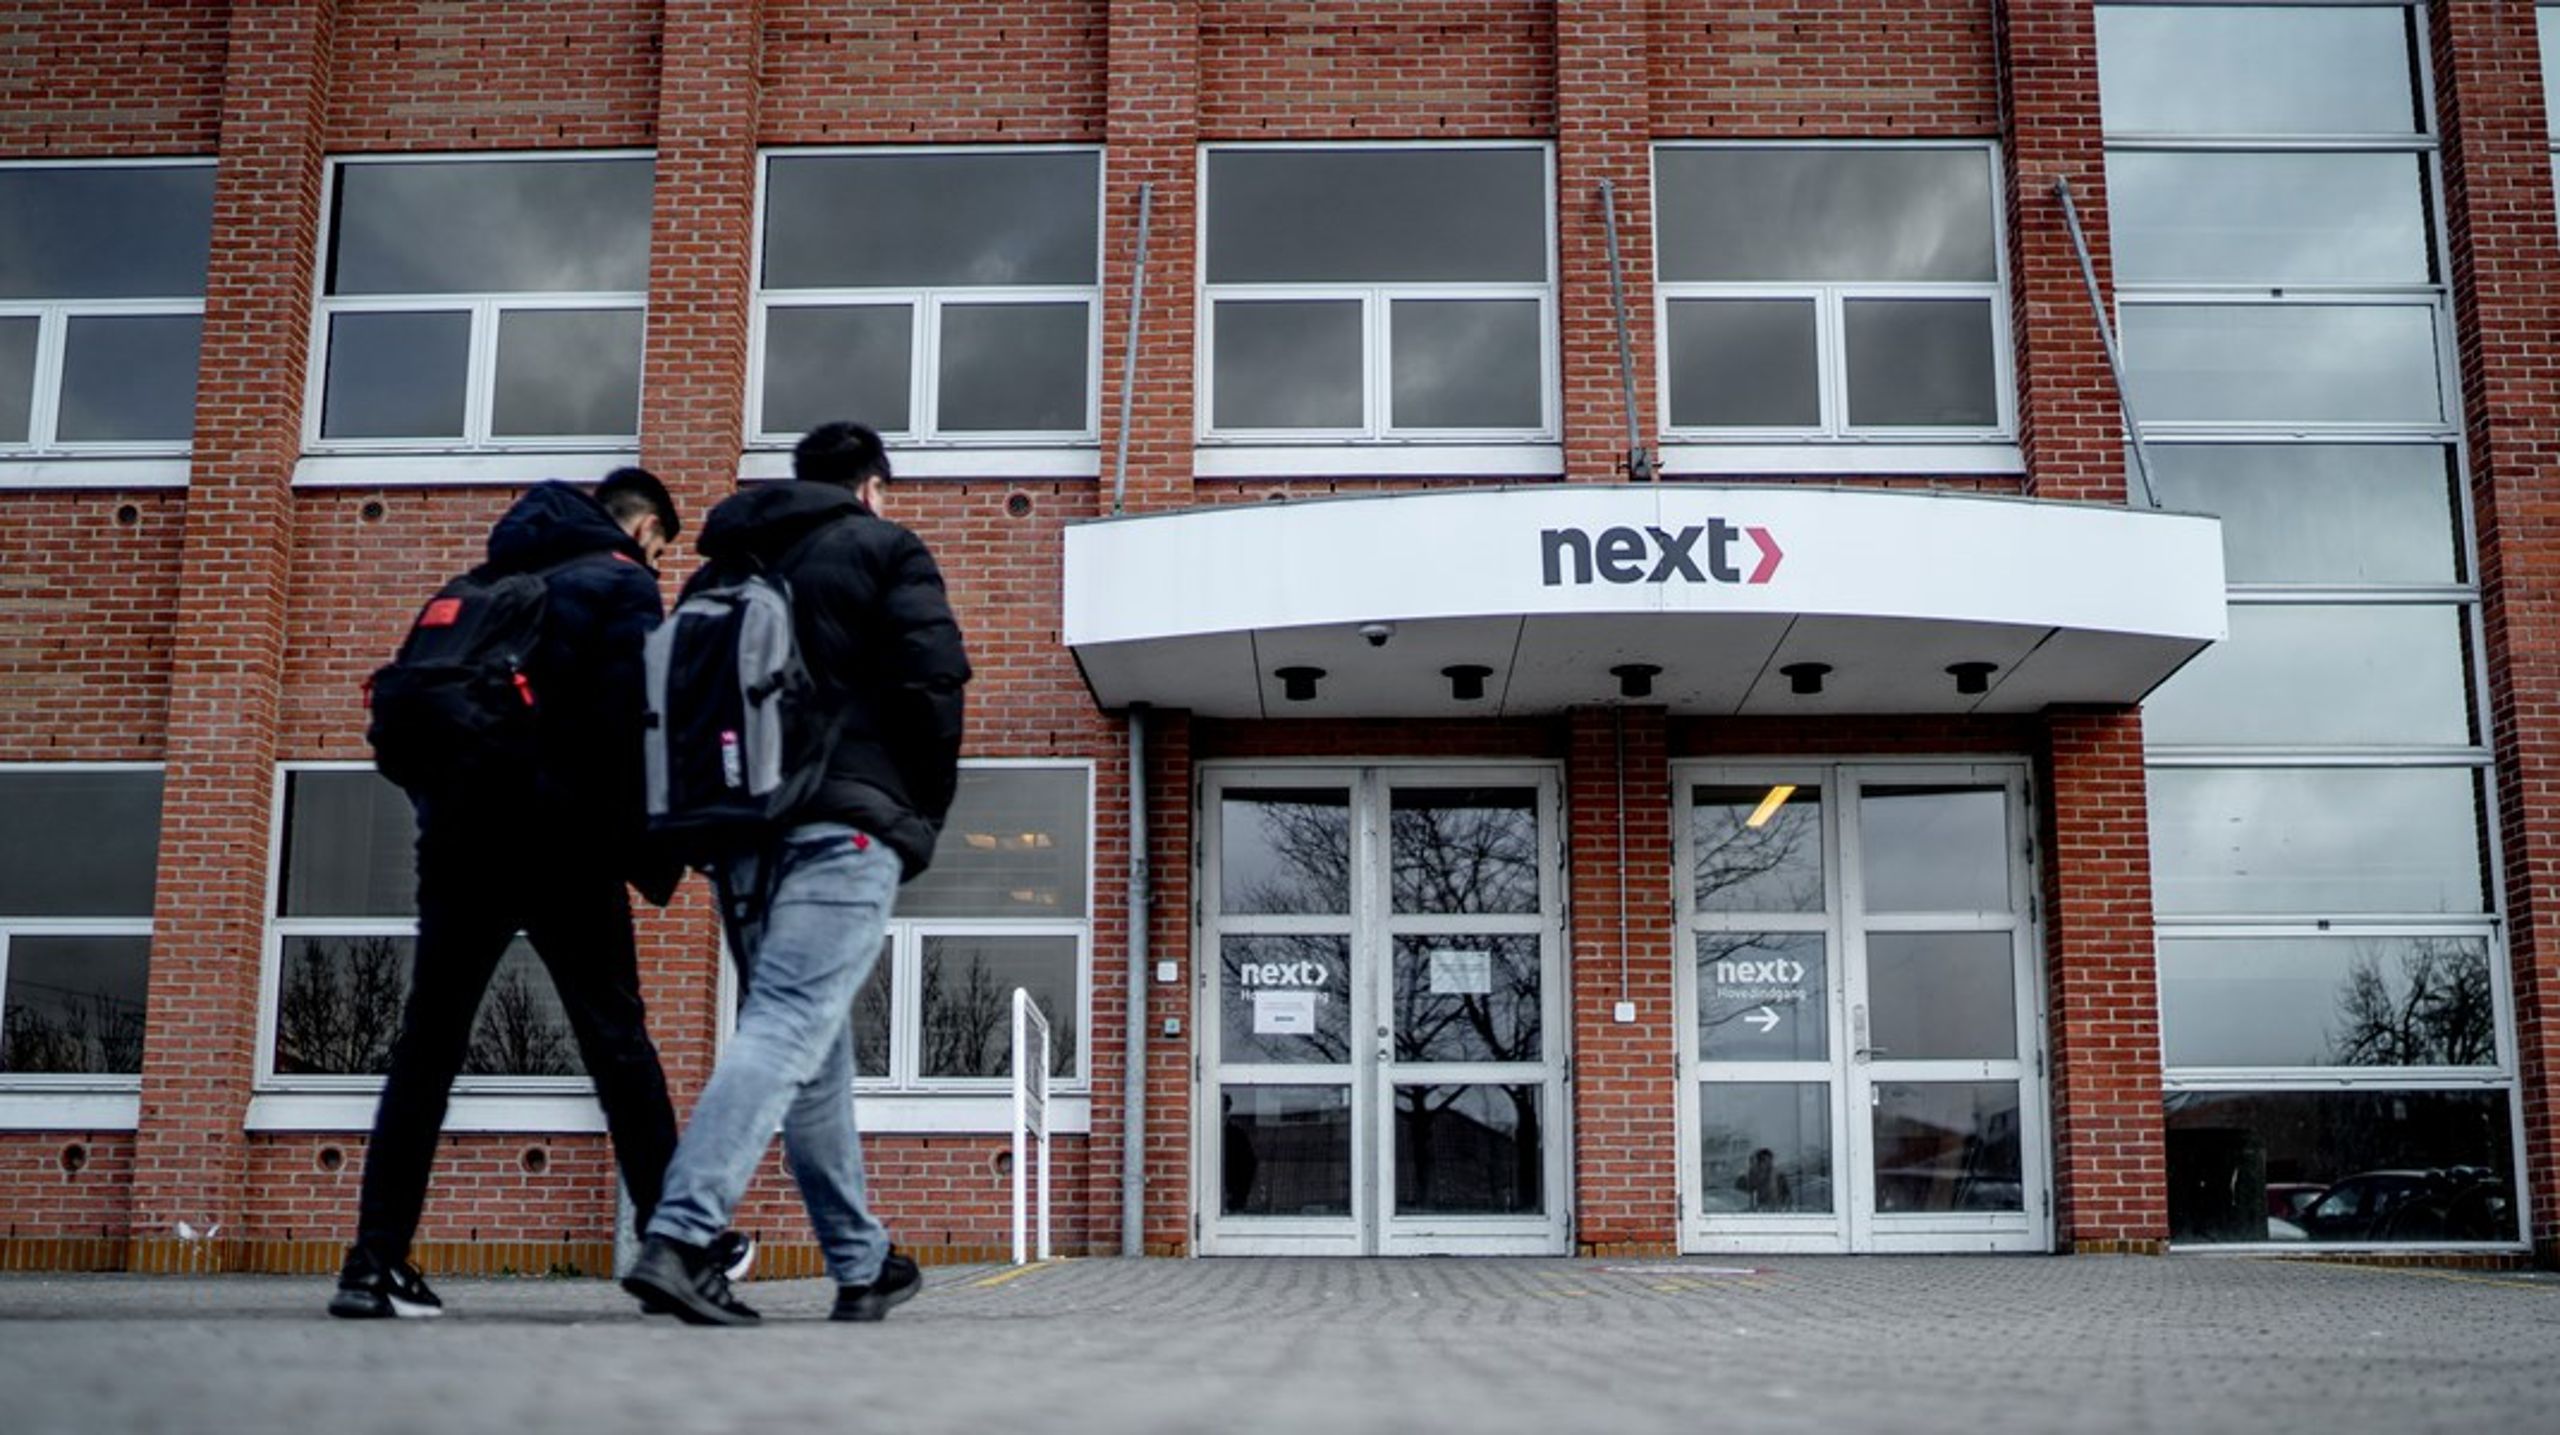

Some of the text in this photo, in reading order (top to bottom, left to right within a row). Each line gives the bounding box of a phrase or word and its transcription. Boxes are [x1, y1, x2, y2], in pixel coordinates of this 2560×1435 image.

[1540, 517, 1741, 586] next
[1241, 961, 1313, 986] next
[1717, 959, 1789, 983] next
